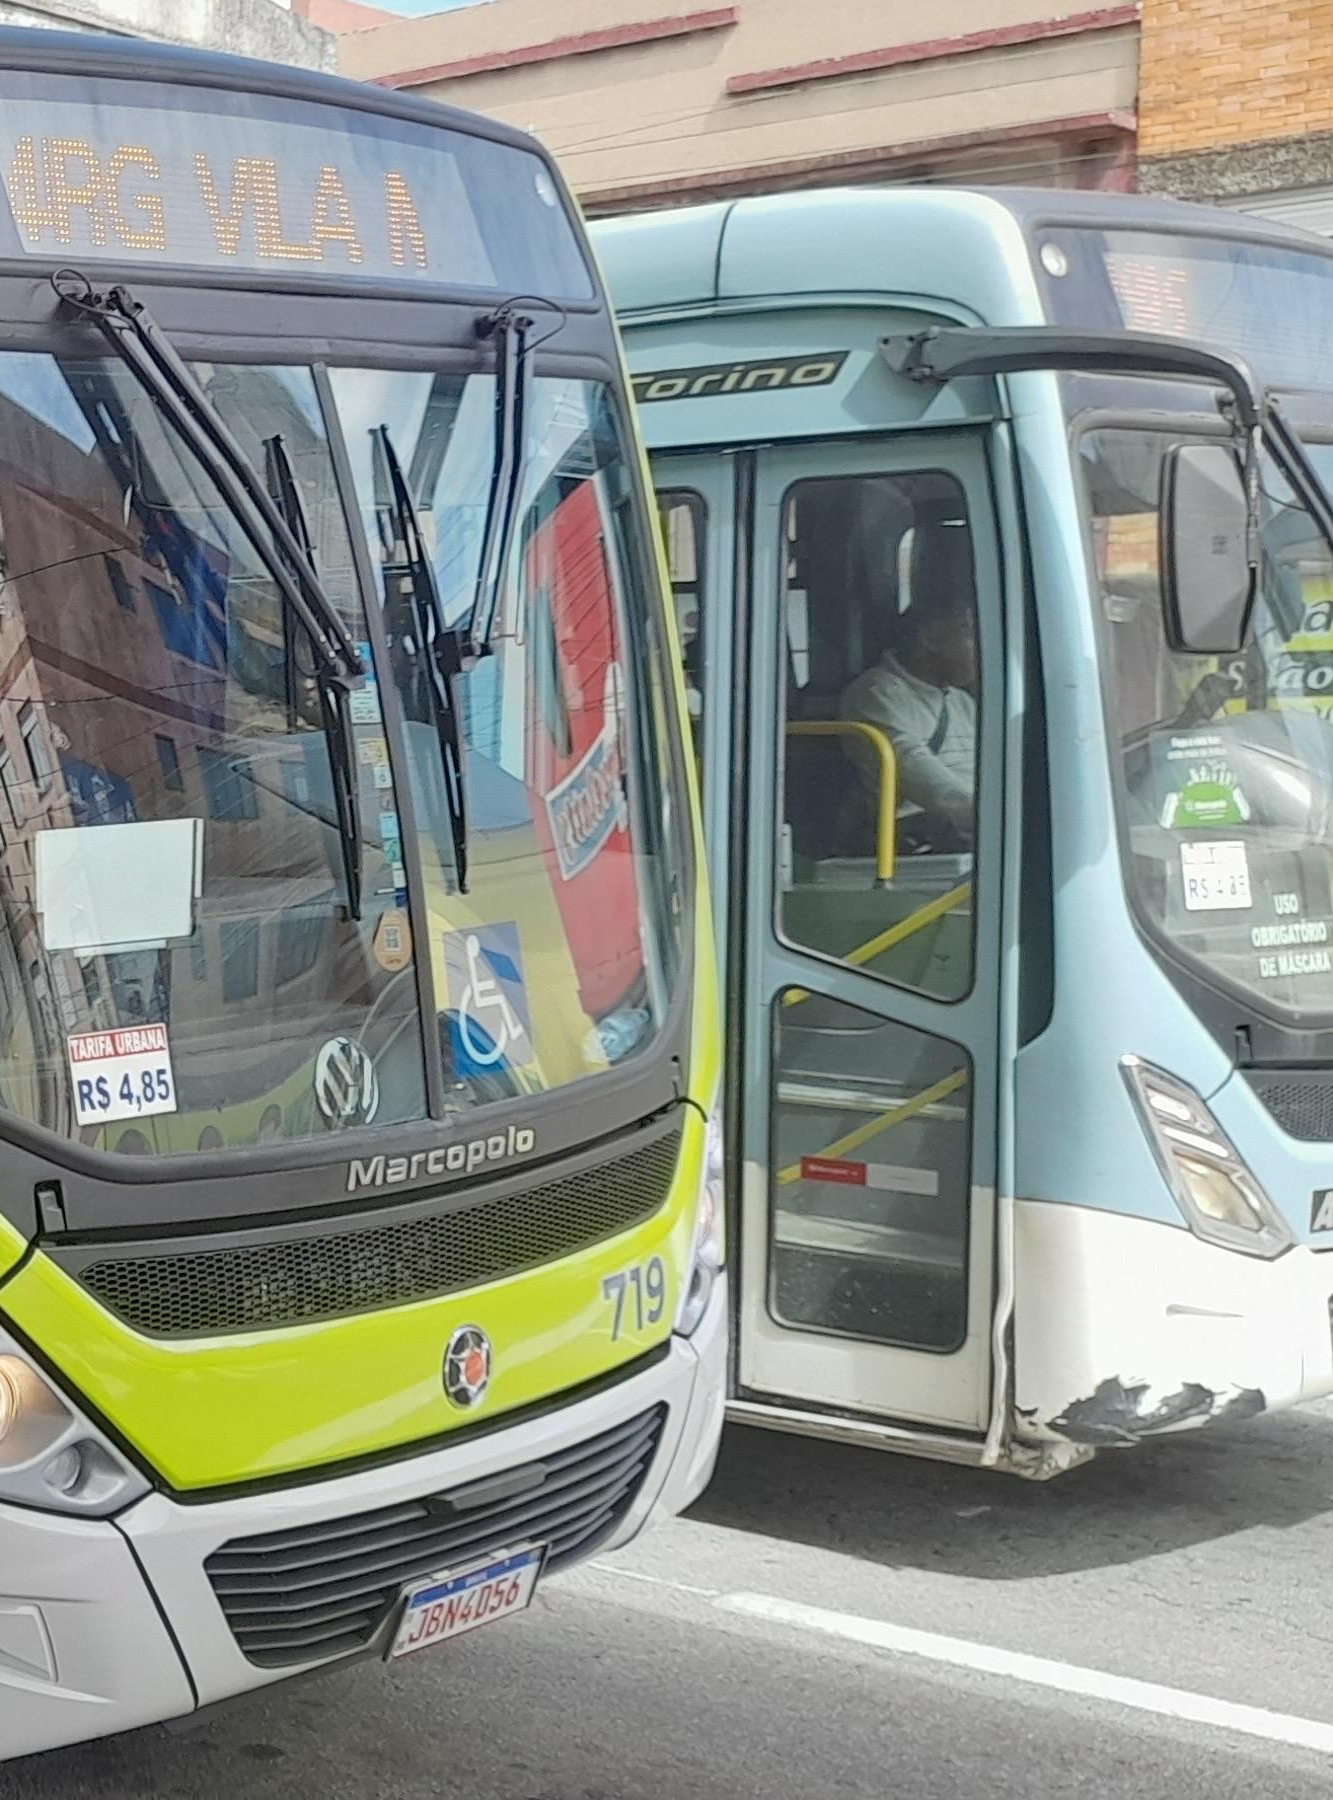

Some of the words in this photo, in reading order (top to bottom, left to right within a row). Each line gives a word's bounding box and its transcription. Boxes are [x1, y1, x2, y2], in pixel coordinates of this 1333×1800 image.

[191, 152, 363, 263] VILA
[1273, 893, 1299, 915] USO
[1251, 919, 1327, 948] OBRIGATÓRIO
[1259, 957, 1278, 978] DE
[70, 1034, 115, 1061] TARIFA
[114, 1027, 166, 1055] URBANA
[77, 1075, 111, 1113] R$
[119, 1068, 170, 1113] 4,85
[347, 1125, 535, 1192] Marcopolo
[603, 1256, 665, 1342] 719
[408, 1571, 522, 1643] JBN4D56
